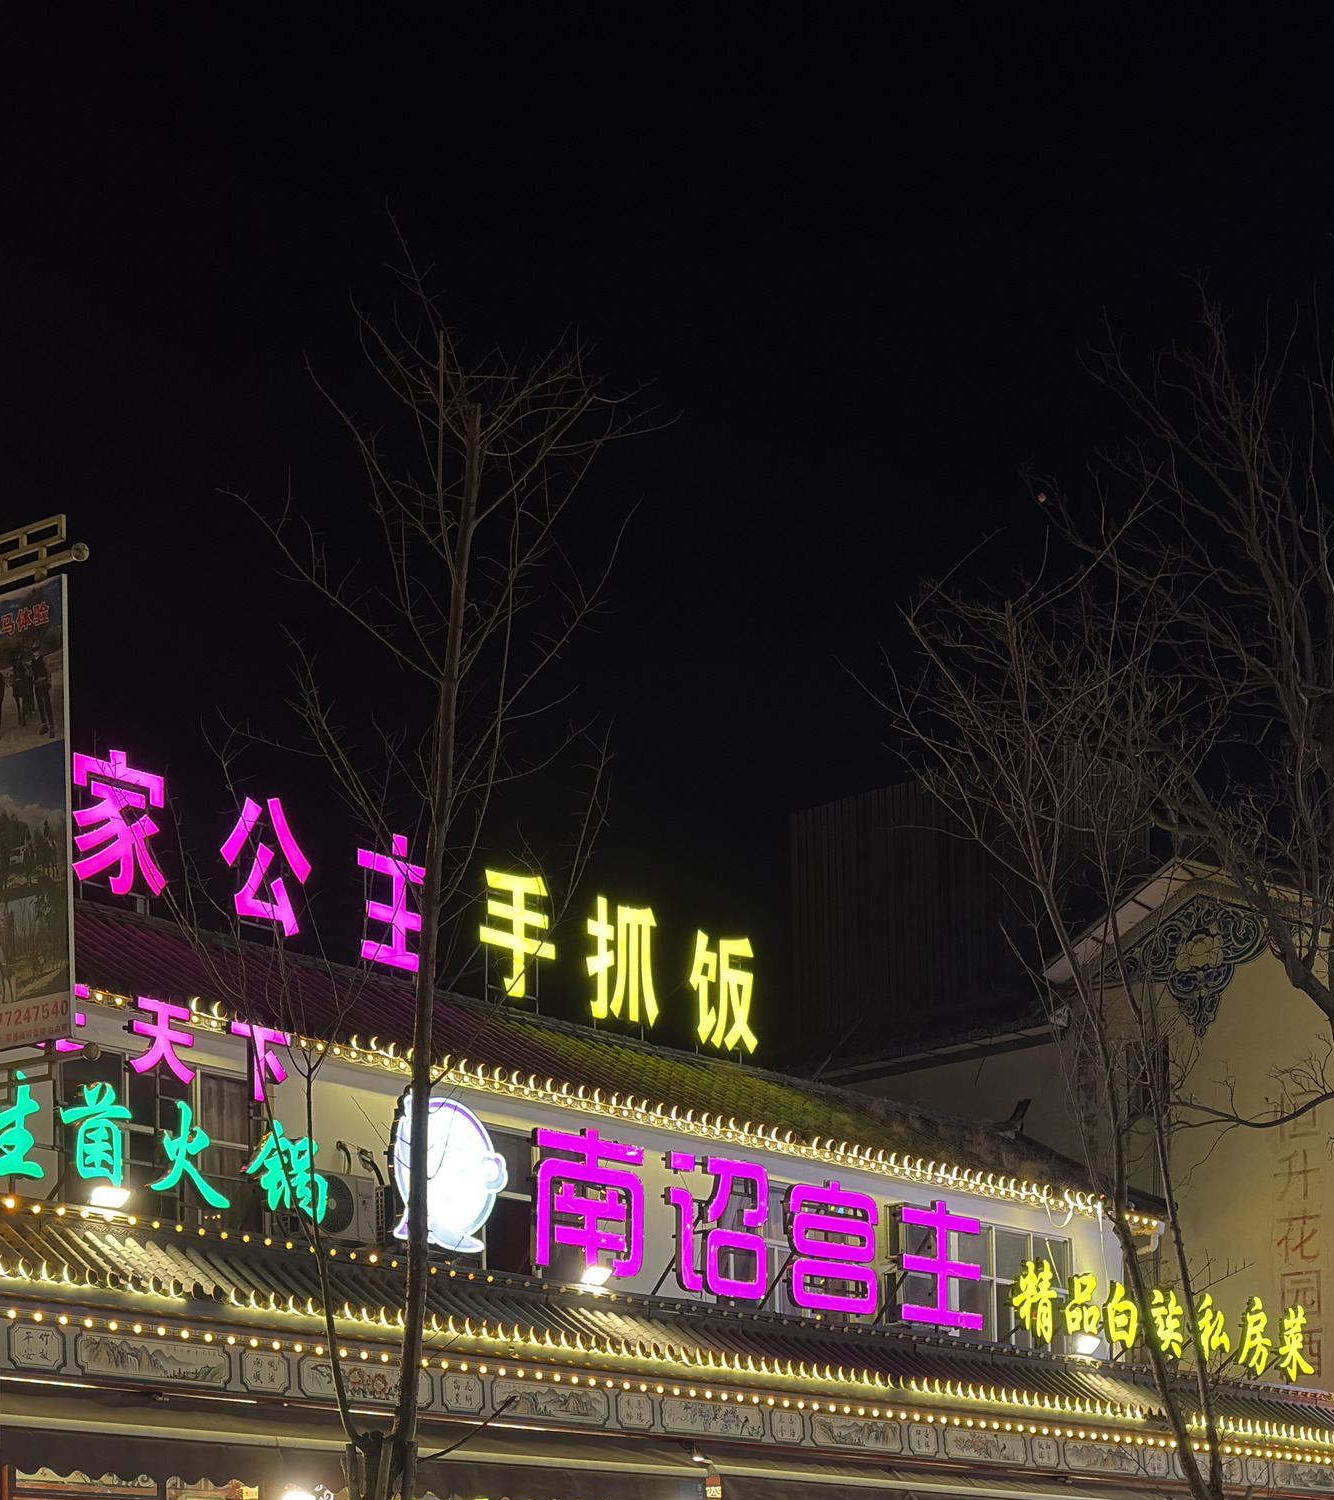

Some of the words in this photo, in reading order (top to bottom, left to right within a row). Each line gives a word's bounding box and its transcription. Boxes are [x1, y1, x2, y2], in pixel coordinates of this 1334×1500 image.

[72, 751, 426, 971] 家公主
[479, 869, 758, 1053] 手抓饭
[38, 984, 291, 1102] 天下
[535, 1127, 984, 1330] 南诏宫主
